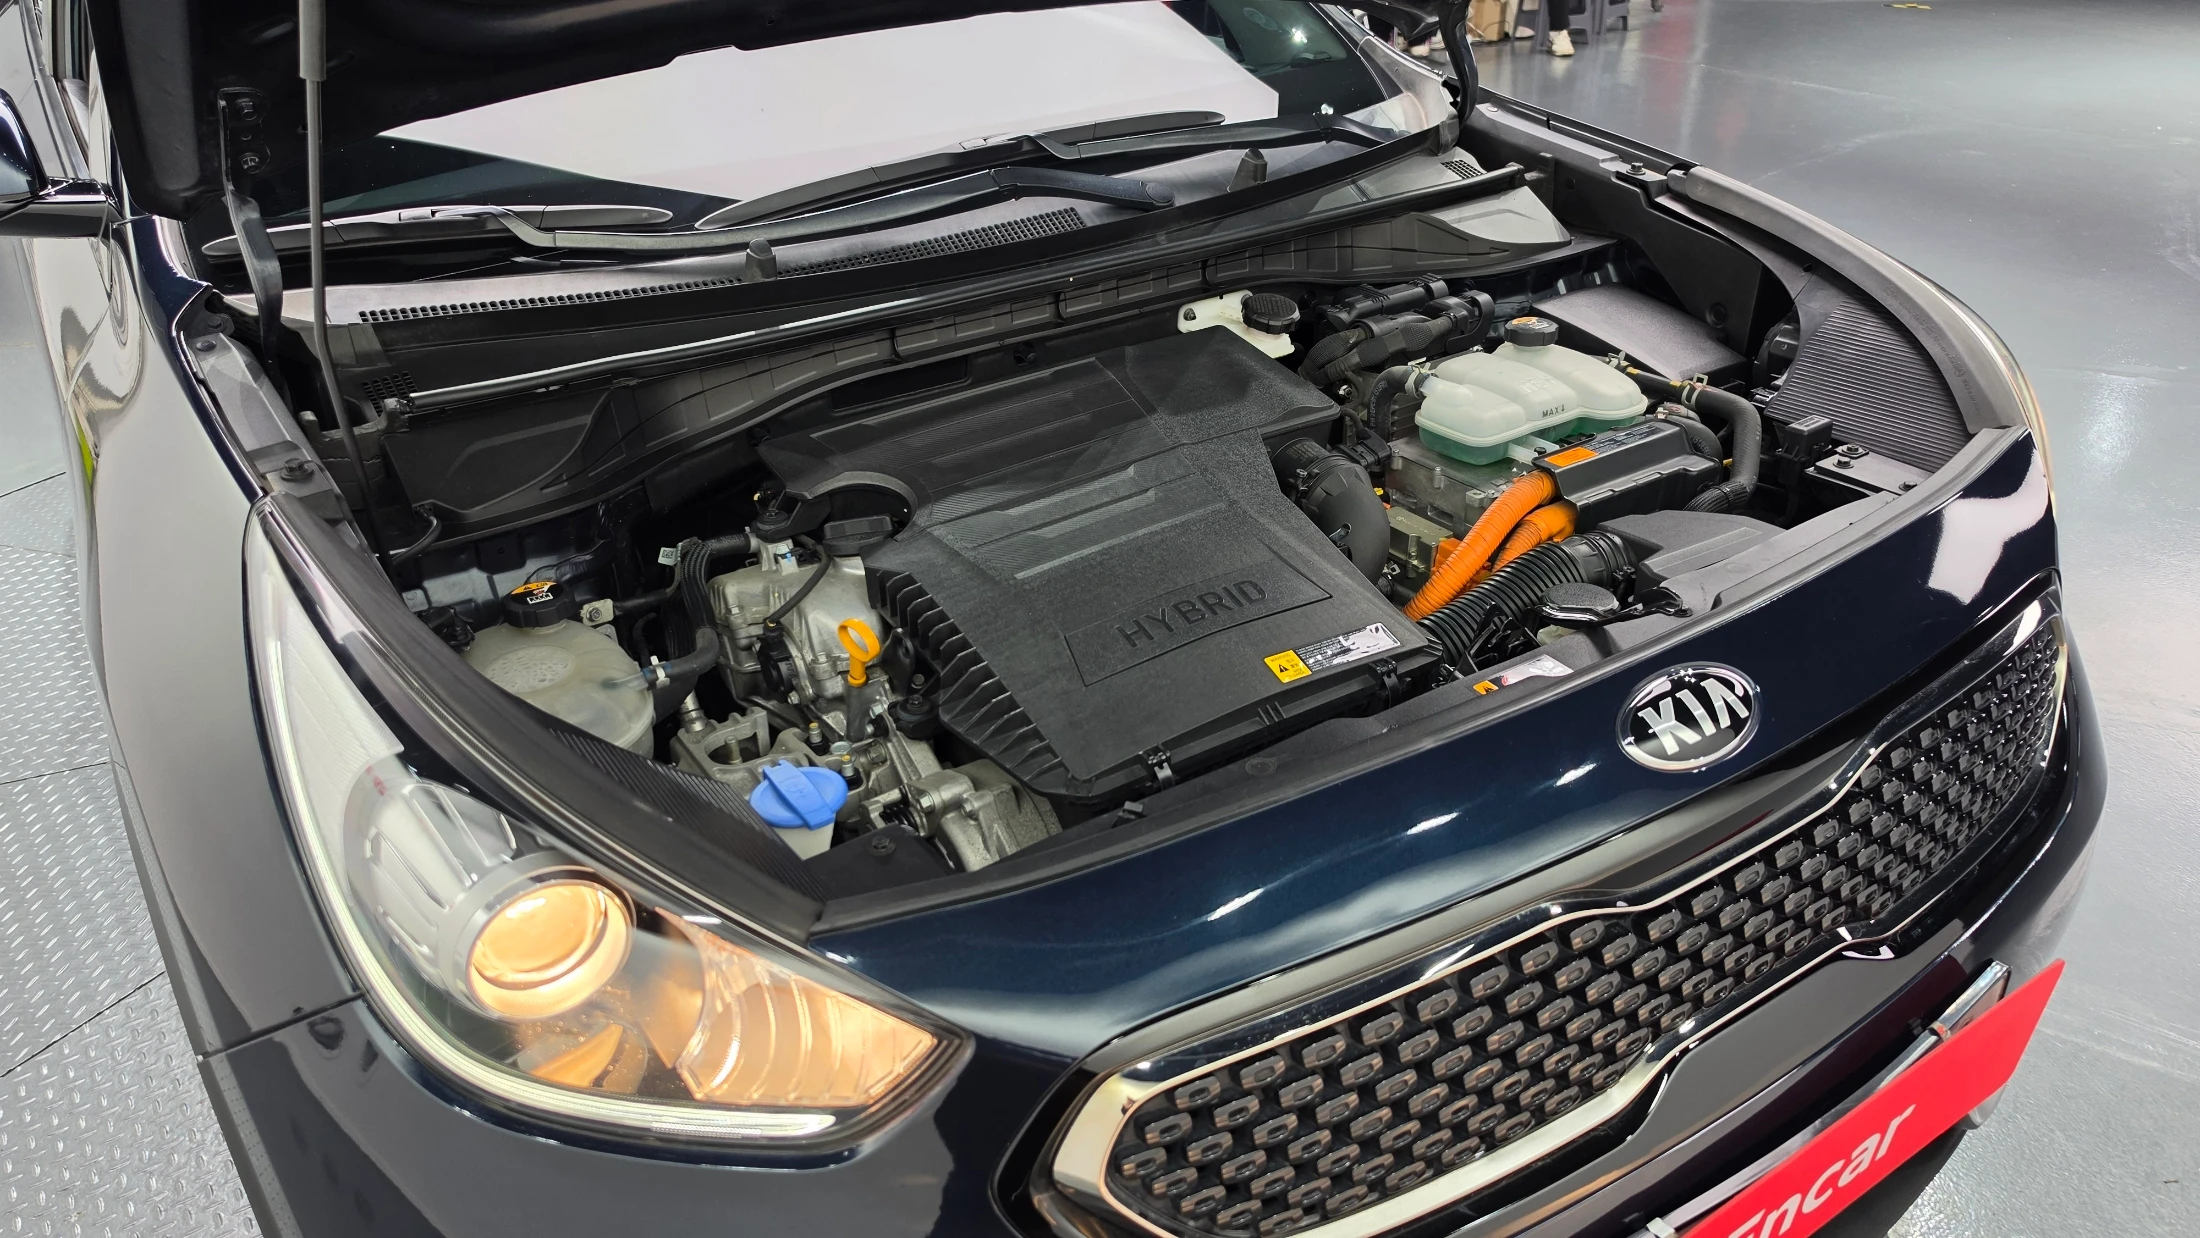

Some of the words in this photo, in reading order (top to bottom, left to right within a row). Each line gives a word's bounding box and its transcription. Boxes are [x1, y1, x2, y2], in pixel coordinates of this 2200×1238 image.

[1542, 406, 1560, 418] MAX
[1114, 580, 1268, 648] HYBRID
[1637, 677, 1750, 756] KIA
